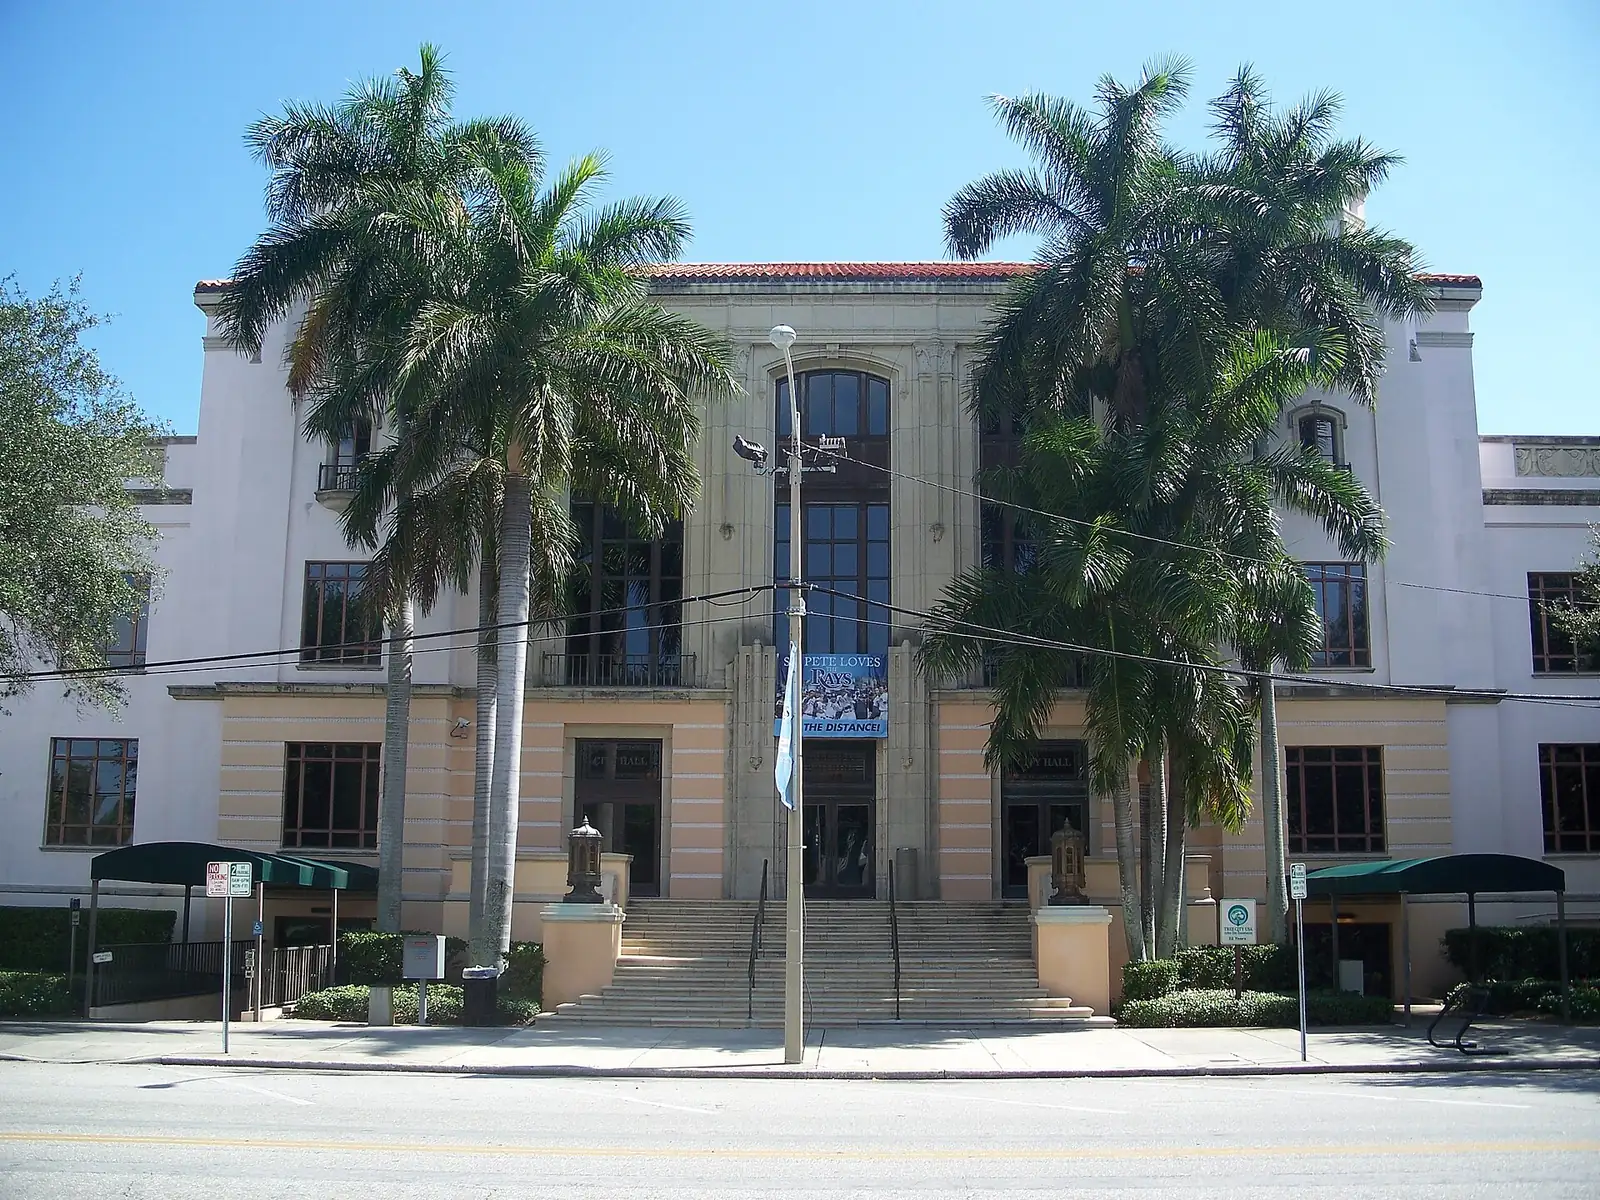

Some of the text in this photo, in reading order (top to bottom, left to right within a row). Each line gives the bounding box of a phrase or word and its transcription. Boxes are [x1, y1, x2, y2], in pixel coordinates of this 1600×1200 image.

[804, 656, 837, 667] PETE
[841, 656, 881, 668] LOVES
[804, 723, 881, 732] THE DISTANCE!
[620, 756, 648, 766] HALL
[1042, 757, 1072, 767] HALL
[209, 864, 219, 873] NO
[231, 865, 237, 875] 2
